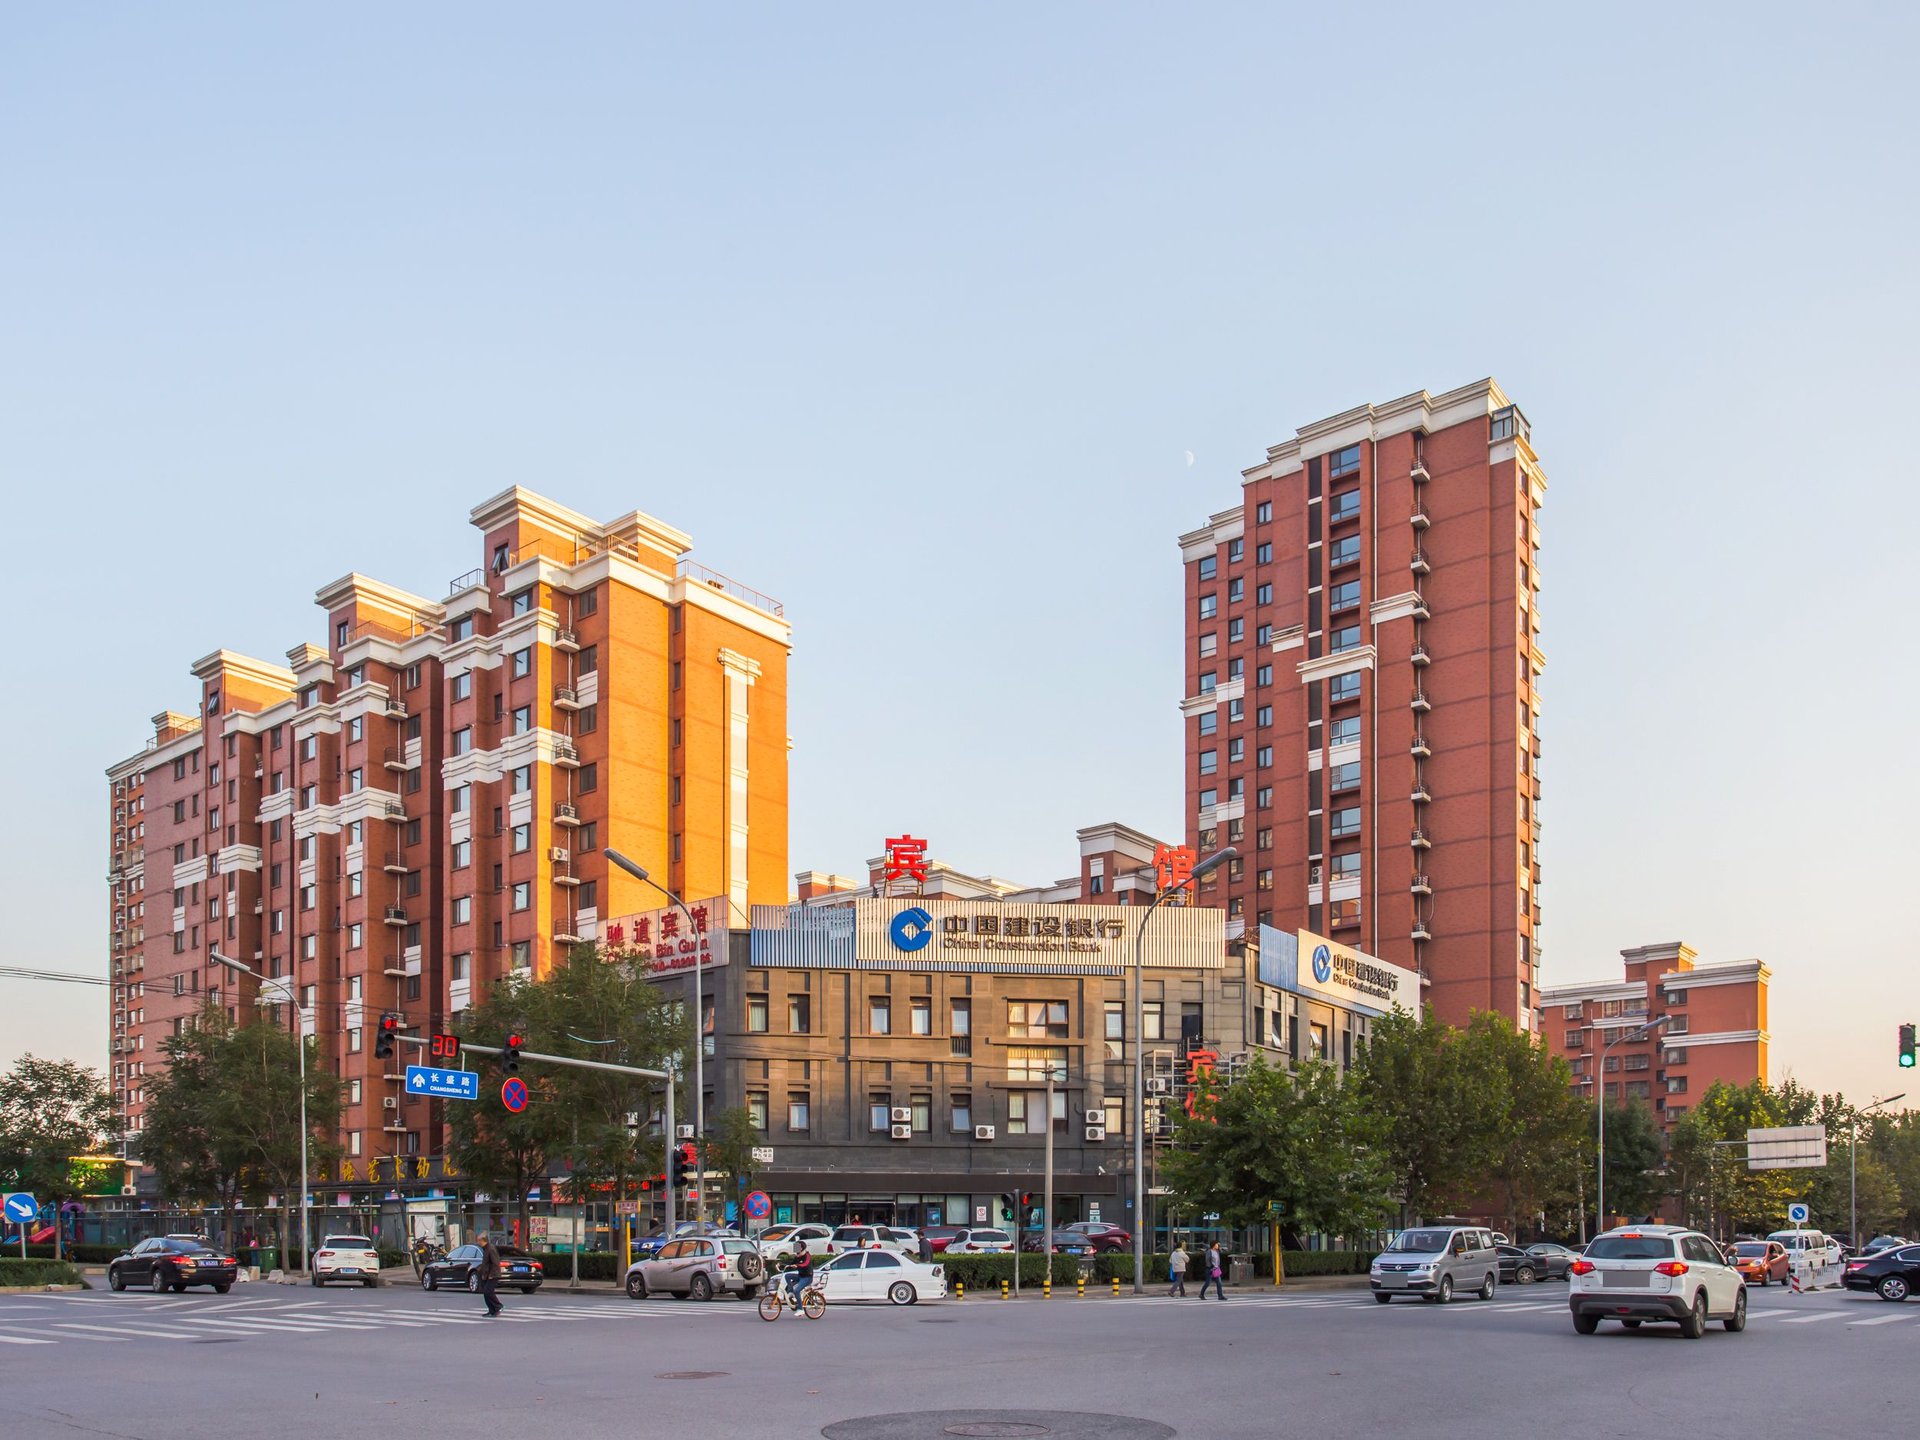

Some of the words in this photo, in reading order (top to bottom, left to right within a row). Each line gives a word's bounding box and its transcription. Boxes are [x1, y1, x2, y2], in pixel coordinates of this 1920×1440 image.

[884, 834, 928, 883] 宾
[1151, 843, 1197, 890] 馆
[942, 915, 1125, 939] 中国建设银行
[655, 943, 674, 958] Bin
[678, 938, 709, 954] Gun
[943, 937, 980, 950] China
[984, 939, 1065, 952] Construction
[1068, 941, 1102, 953] Bank
[432, 1035, 457, 1057] 30
[429, 1085, 463, 1094] CHANGSHENG
[430, 1072, 470, 1087] 长盛路
